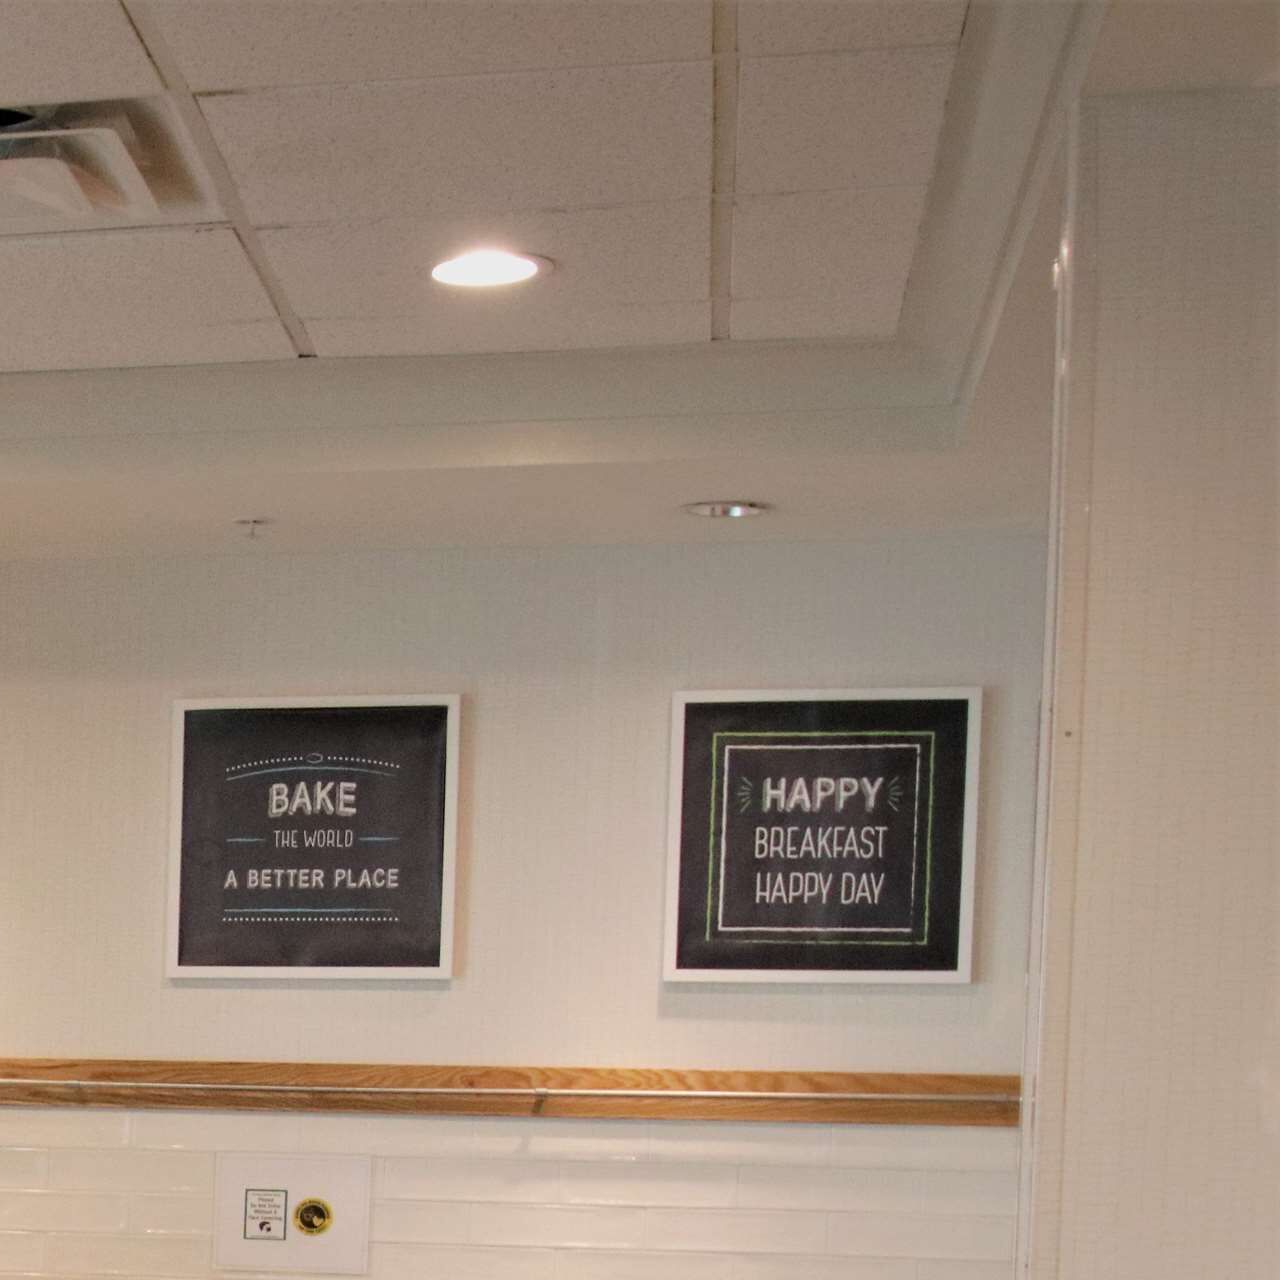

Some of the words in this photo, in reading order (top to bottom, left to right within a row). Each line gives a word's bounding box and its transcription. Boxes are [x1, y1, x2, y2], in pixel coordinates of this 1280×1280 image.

[268, 781, 357, 818] BAKE
[762, 777, 884, 813] HAPPY
[273, 830, 298, 848] THE
[303, 830, 353, 848] WORLD
[754, 826, 888, 859] BREAKFAST
[224, 869, 238, 889] A
[247, 869, 324, 889] BETTER
[334, 868, 399, 888] PLACE
[755, 872, 833, 904] HAPPY
[841, 872, 885, 904] DAY
